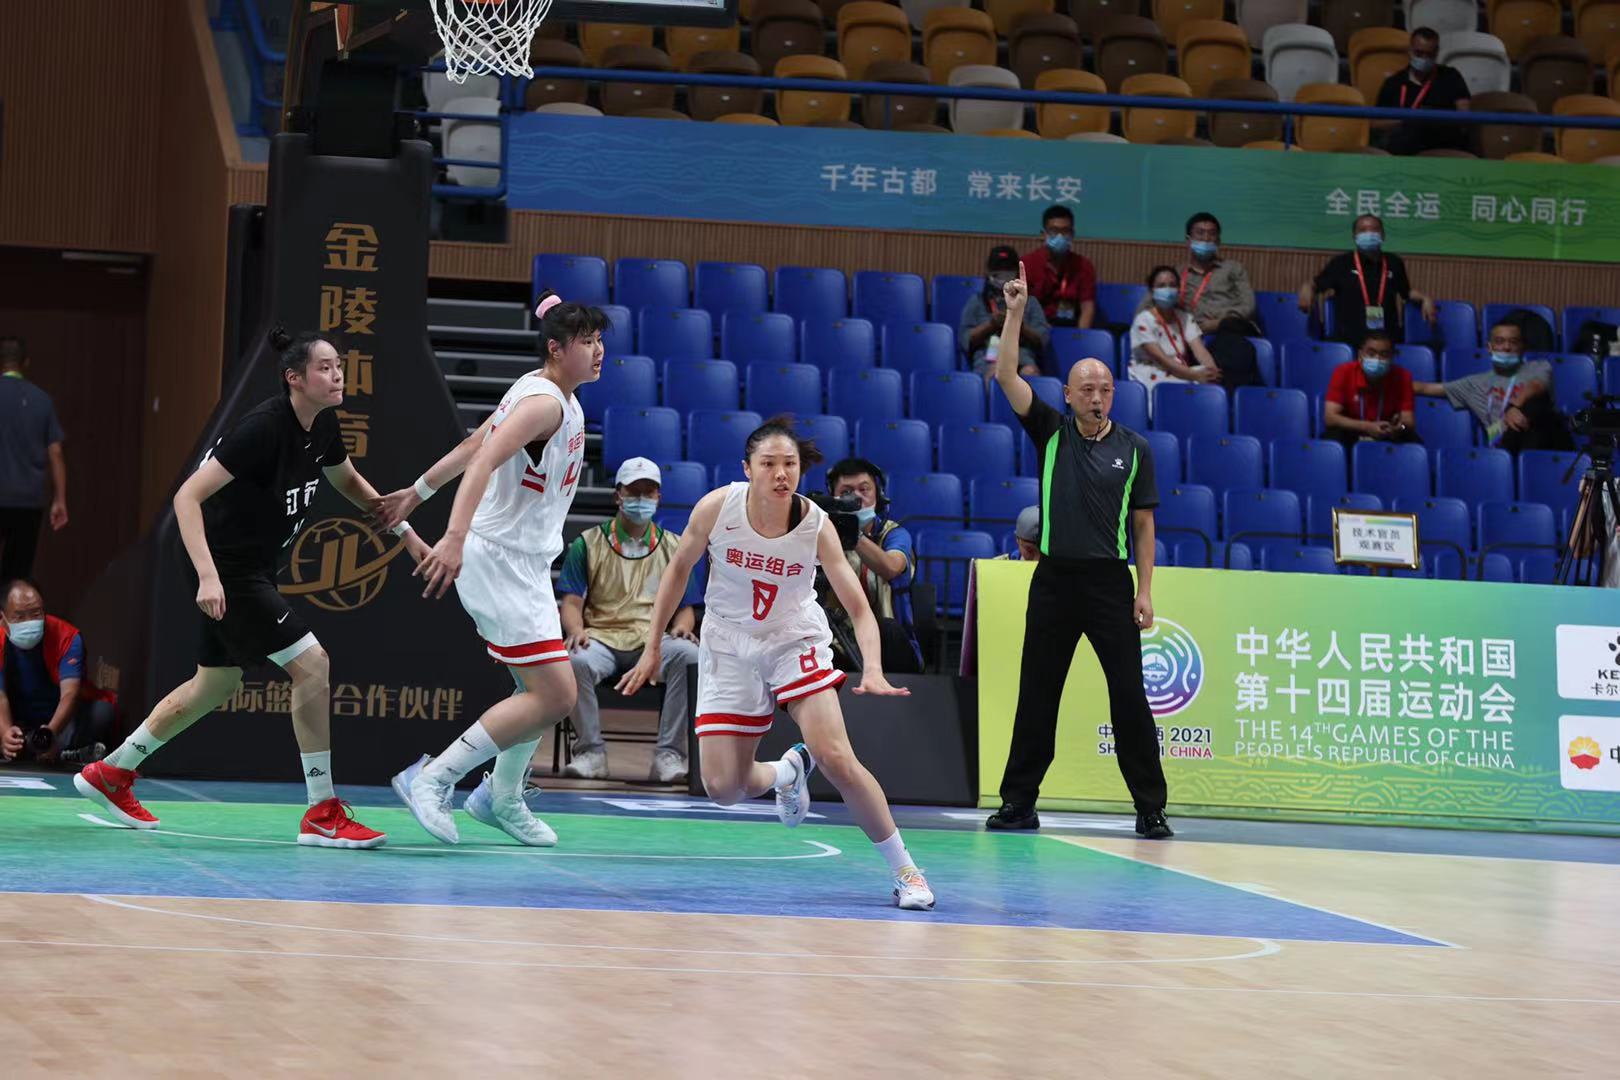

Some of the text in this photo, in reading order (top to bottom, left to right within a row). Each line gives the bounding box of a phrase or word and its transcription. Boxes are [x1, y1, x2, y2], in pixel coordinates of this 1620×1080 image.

[820, 164, 1083, 203] 千年古都 常来长安
[1325, 188, 1588, 226] 全民全运 同心同行
[726, 548, 804, 578] 奥运组合
[1235, 627, 1516, 678] 中华人民共和国
[1235, 671, 1516, 724] 第十四届运动会
[1170, 727, 1211, 743] 2021
[1235, 719, 1283, 740] THE
[1332, 723, 1421, 747] GAMES
[1427, 727, 1460, 748] OF
[1465, 729, 1514, 751] THE
[1170, 746, 1212, 758] CHINA
[1329, 745, 1420, 765] REPUBLIC
[1425, 750, 1450, 766] OF
[1455, 751, 1515, 769] CHINA
